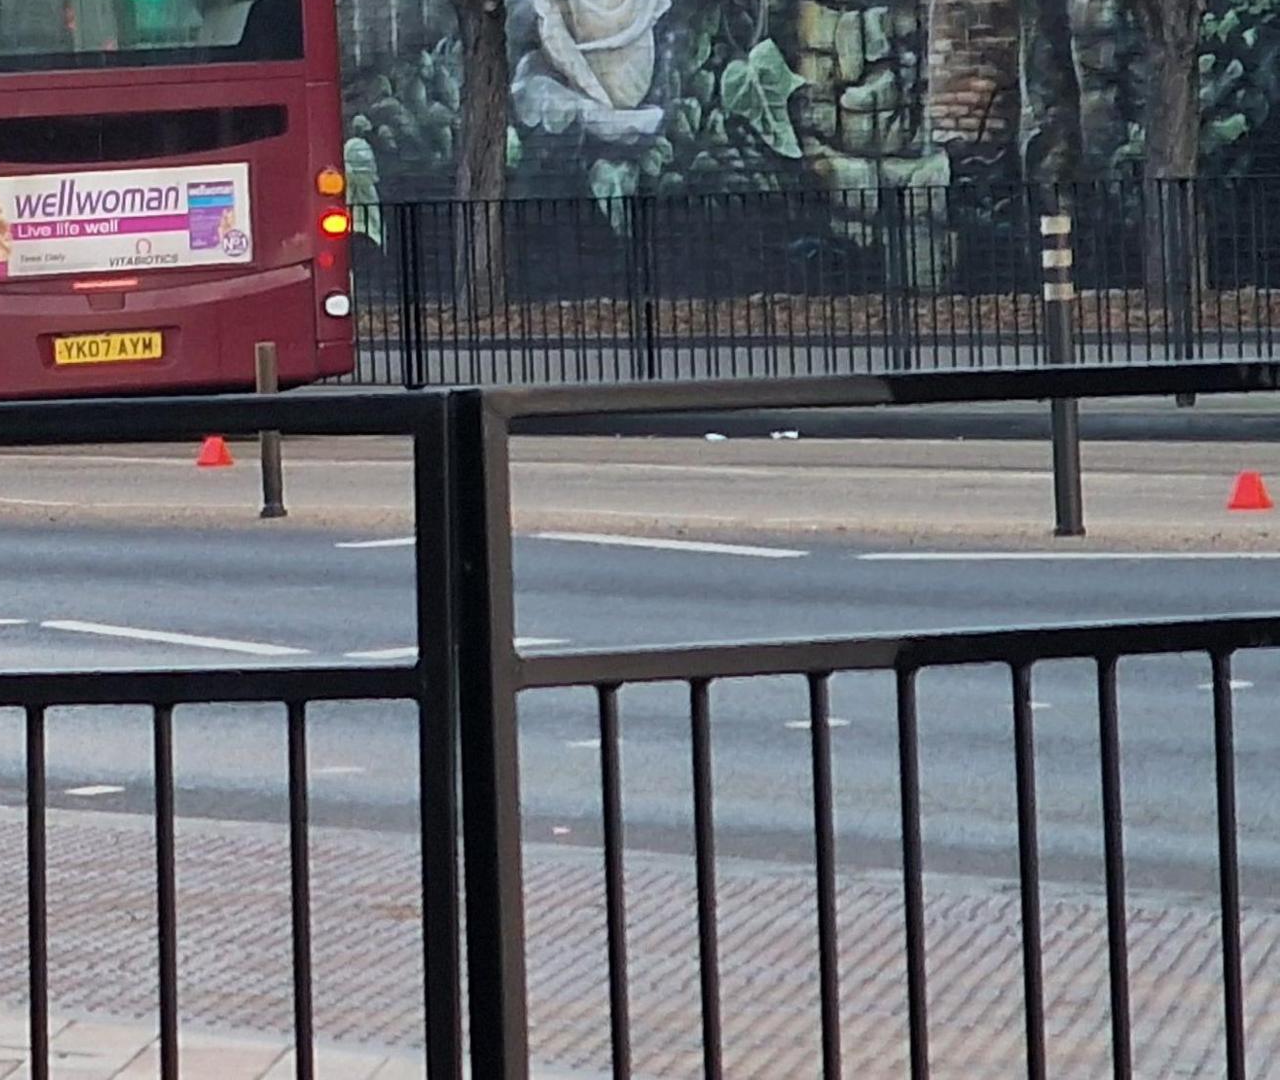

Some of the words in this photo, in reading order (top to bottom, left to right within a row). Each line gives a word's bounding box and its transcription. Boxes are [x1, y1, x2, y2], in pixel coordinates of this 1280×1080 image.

[15, 179, 180, 219] wellwoman
[17, 223, 52, 238] Live
[56, 220, 80, 236] life
[85, 219, 119, 234] well
[109, 253, 179, 268] VITABIOTICS
[64, 339, 112, 360] YK07
[117, 336, 153, 356] AYM
